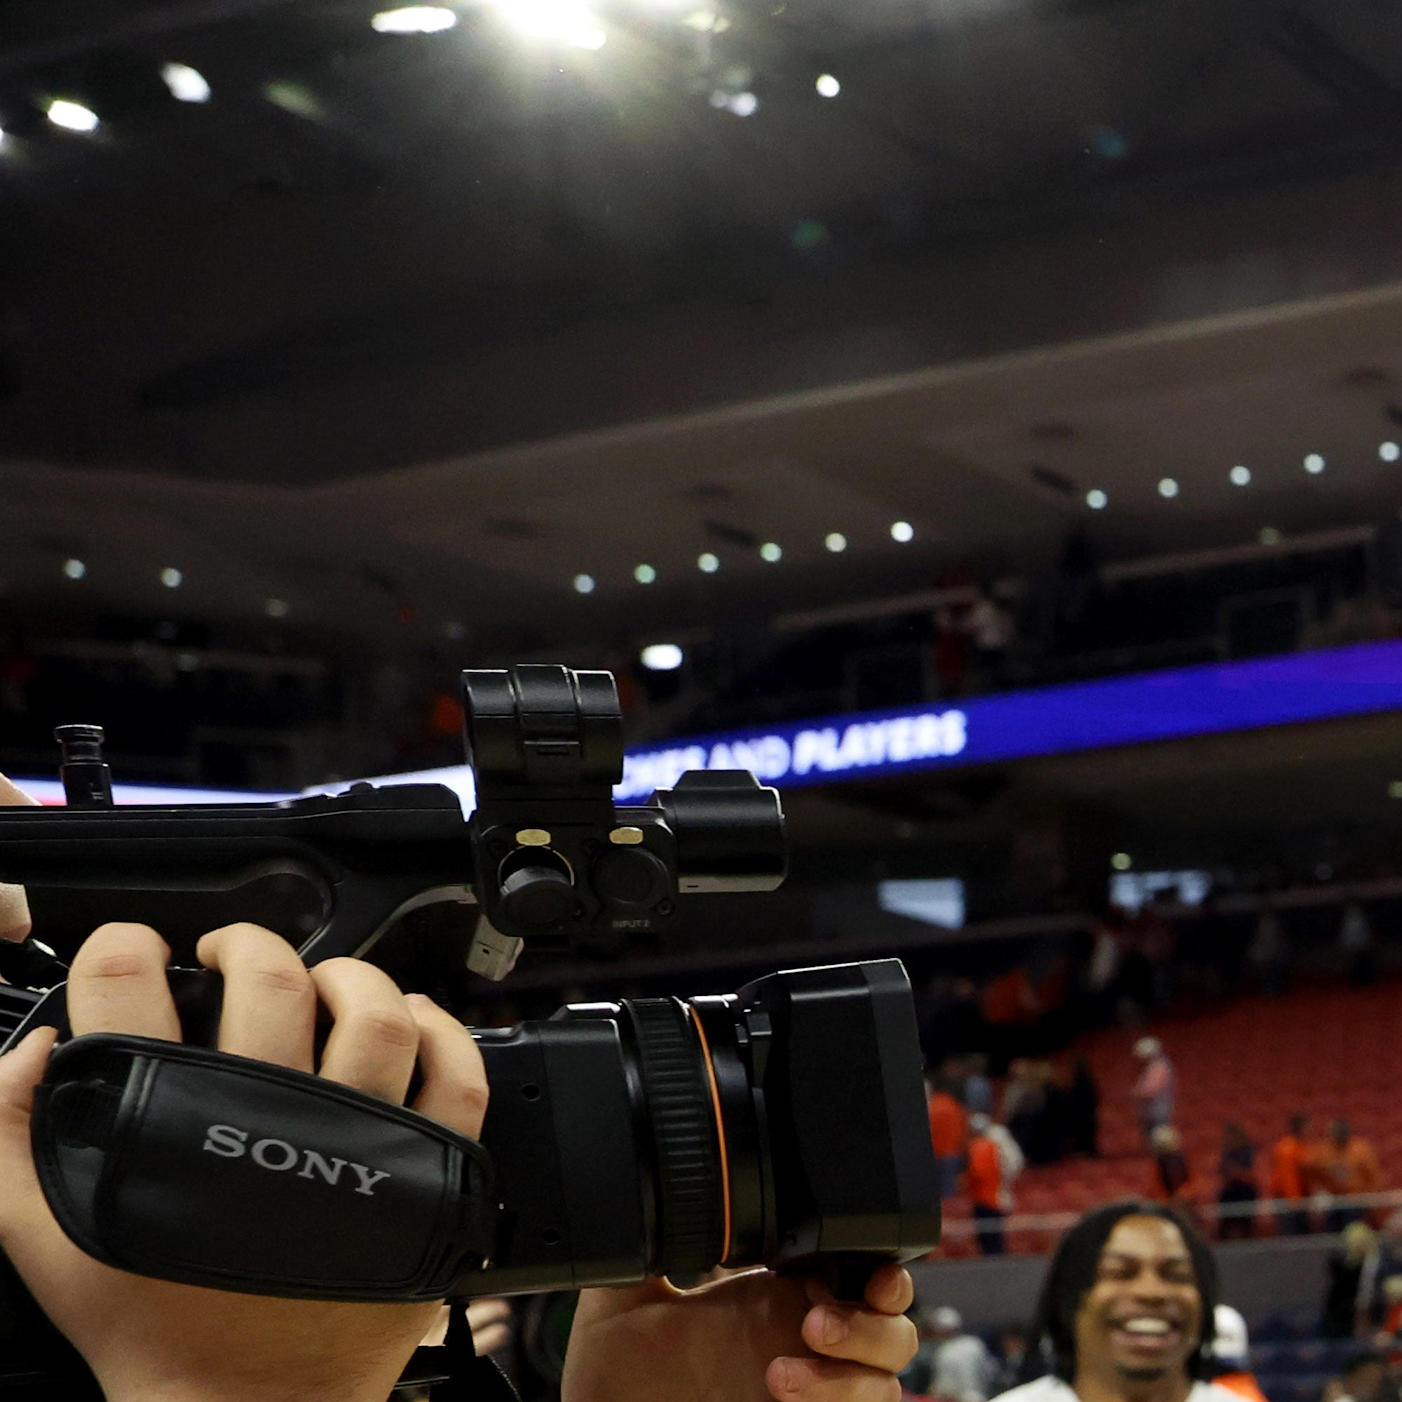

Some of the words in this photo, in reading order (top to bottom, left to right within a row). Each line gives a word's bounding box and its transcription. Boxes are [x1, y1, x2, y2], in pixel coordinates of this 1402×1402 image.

[707, 735, 791, 780] AND
[793, 709, 967, 775] PLAYERS
[202, 1122, 390, 1197] SONY
